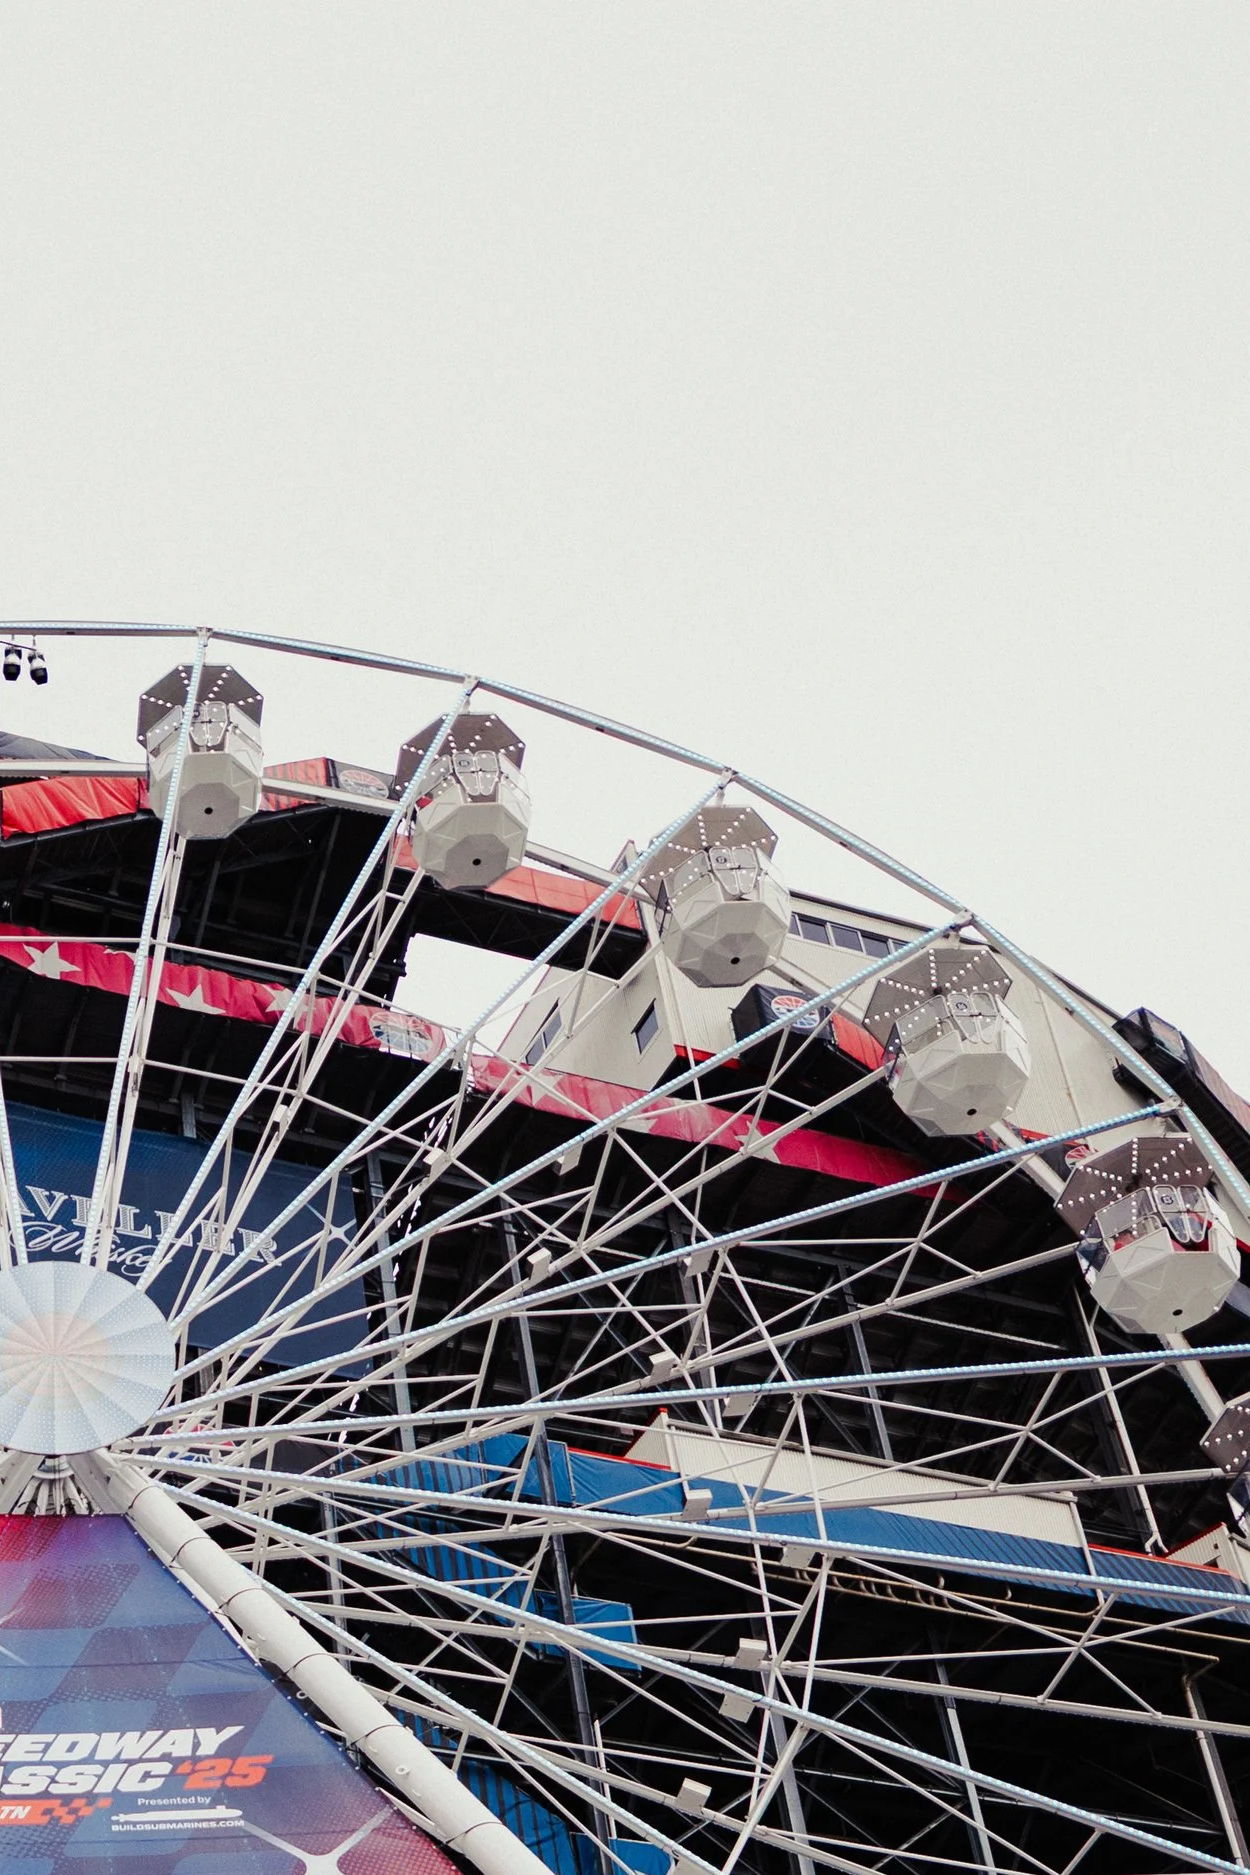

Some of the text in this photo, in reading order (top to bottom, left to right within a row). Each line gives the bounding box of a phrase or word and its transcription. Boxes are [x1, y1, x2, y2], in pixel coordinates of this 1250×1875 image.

[137, 1796, 212, 1807] Presented by
[111, 1820, 245, 1832] BUILDSUBMARINES.COM
